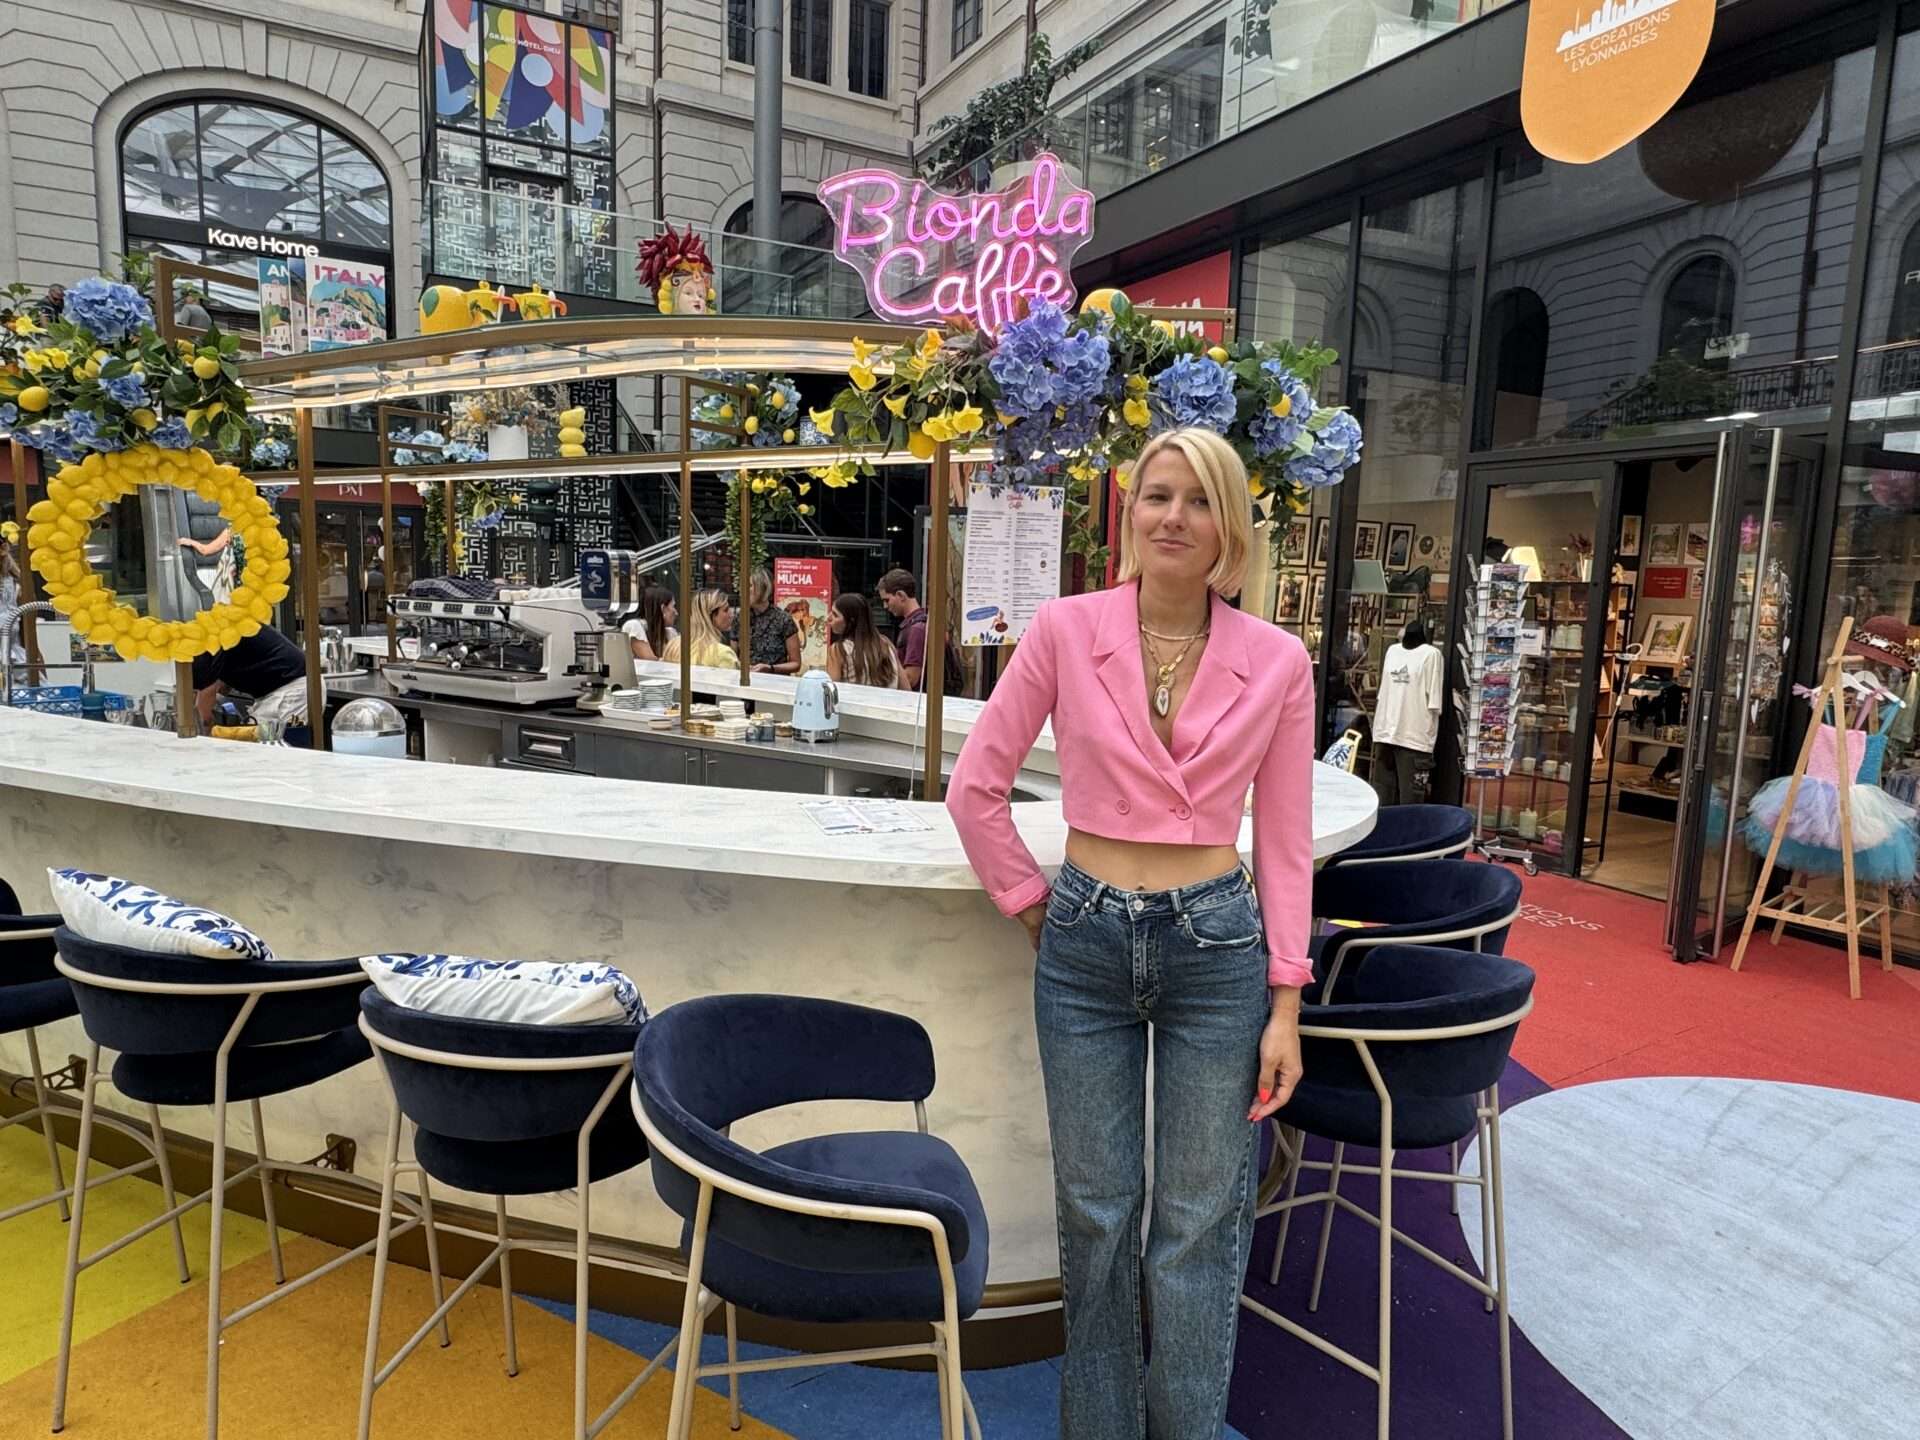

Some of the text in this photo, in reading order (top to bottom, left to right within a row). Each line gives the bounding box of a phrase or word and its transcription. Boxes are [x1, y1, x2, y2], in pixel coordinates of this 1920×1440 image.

[1563, 43, 1586, 62] LES
[1572, 27, 1659, 73] LYONNAISES
[823, 158, 1090, 255] Bionda
[207, 228, 319, 258] Kave Home
[314, 264, 385, 288] ITALY
[873, 240, 1072, 342] Caffè
[777, 573, 814, 585] MUCHA
